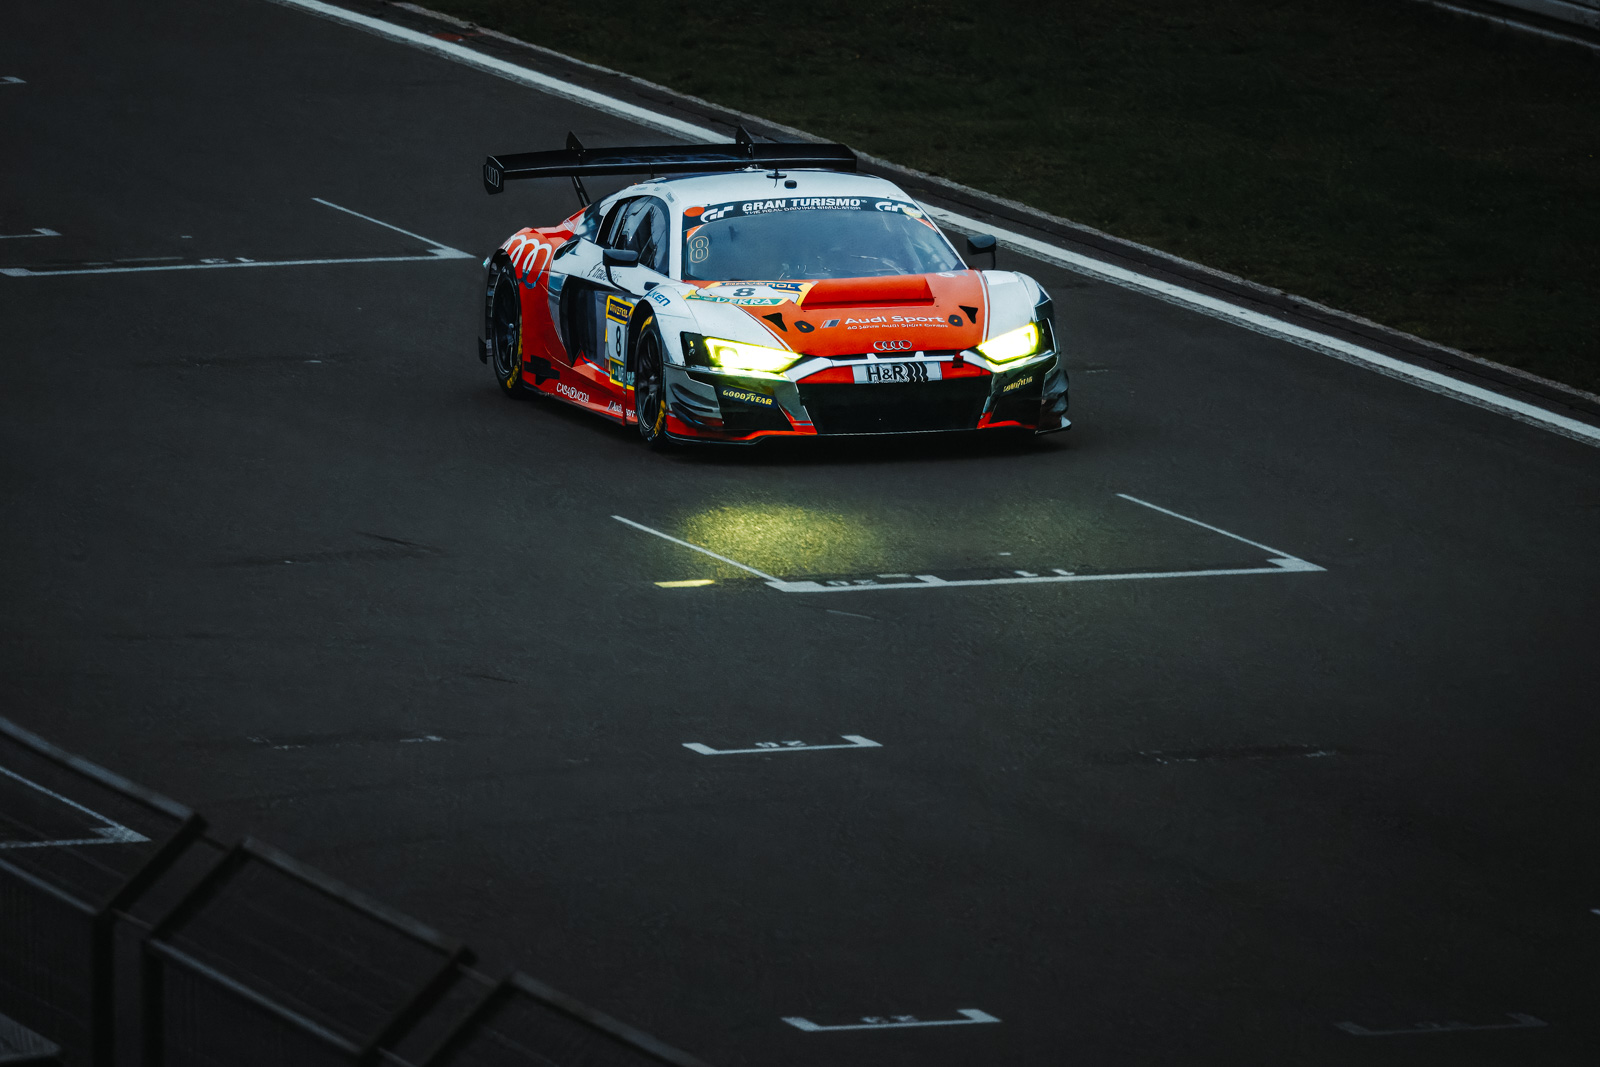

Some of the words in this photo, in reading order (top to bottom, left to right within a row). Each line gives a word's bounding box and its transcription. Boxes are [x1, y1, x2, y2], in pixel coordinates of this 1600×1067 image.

[742, 199, 786, 212] GRAN
[791, 198, 861, 208] TURISMO
[690, 236, 709, 263] 8
[733, 287, 756, 297] 8
[844, 316, 887, 325] Audi
[891, 315, 945, 324] Sport
[615, 325, 622, 357] 8
[867, 365, 906, 382] H&R
[722, 389, 773, 406] GOODYEAR
